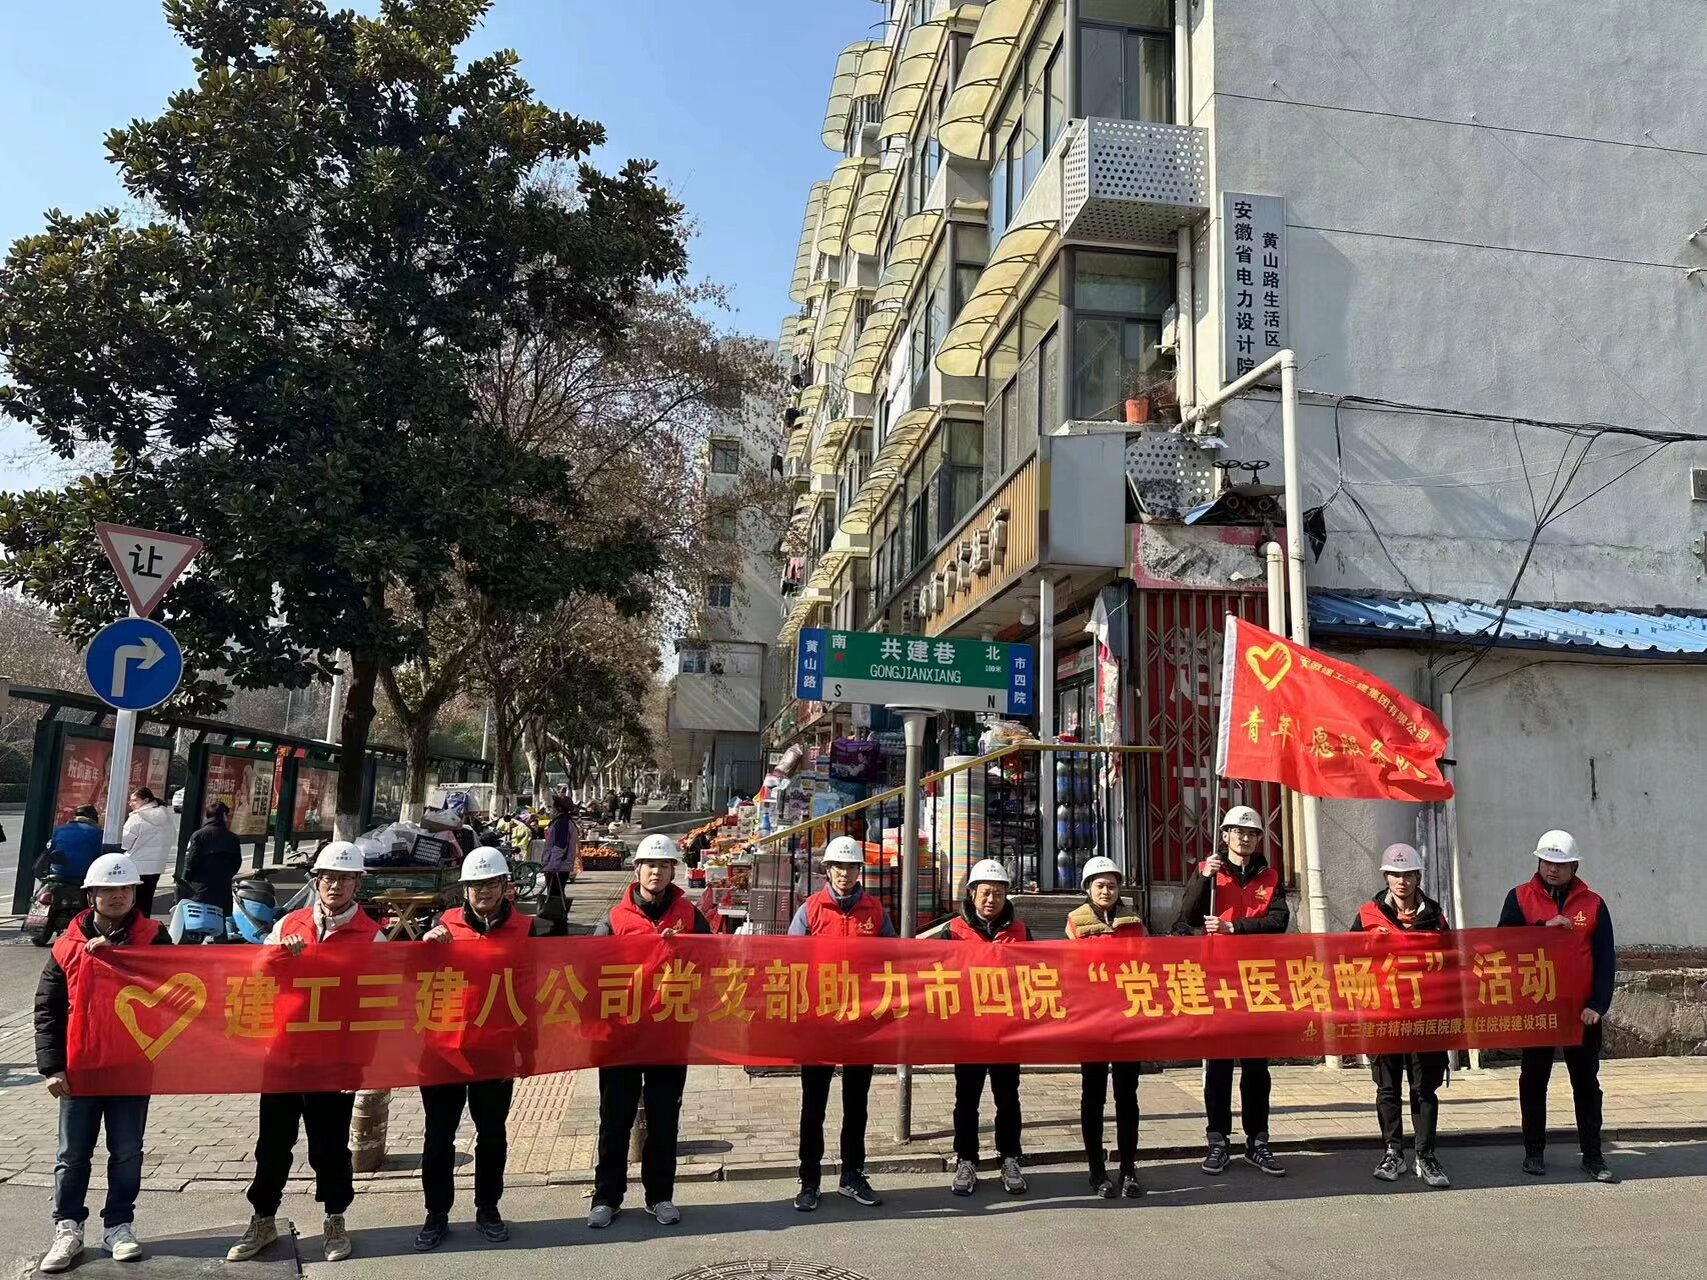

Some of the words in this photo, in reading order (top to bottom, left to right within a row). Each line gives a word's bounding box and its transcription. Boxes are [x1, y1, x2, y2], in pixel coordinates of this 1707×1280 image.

[1234, 201, 1255, 376] 安徽省电力设计院
[1262, 232, 1281, 347] 黄山路生活区
[128, 543, 163, 579] 让
[832, 634, 847, 649] 南
[880, 637, 956, 665] 共建巷
[985, 645, 1001, 661] 北
[803, 640, 819, 689] 黄山路
[870, 664, 962, 684] GONGJIANXIANG
[834, 684, 842, 698] S
[1014, 656, 1027, 704] 市四院
[987, 694, 996, 709] N
